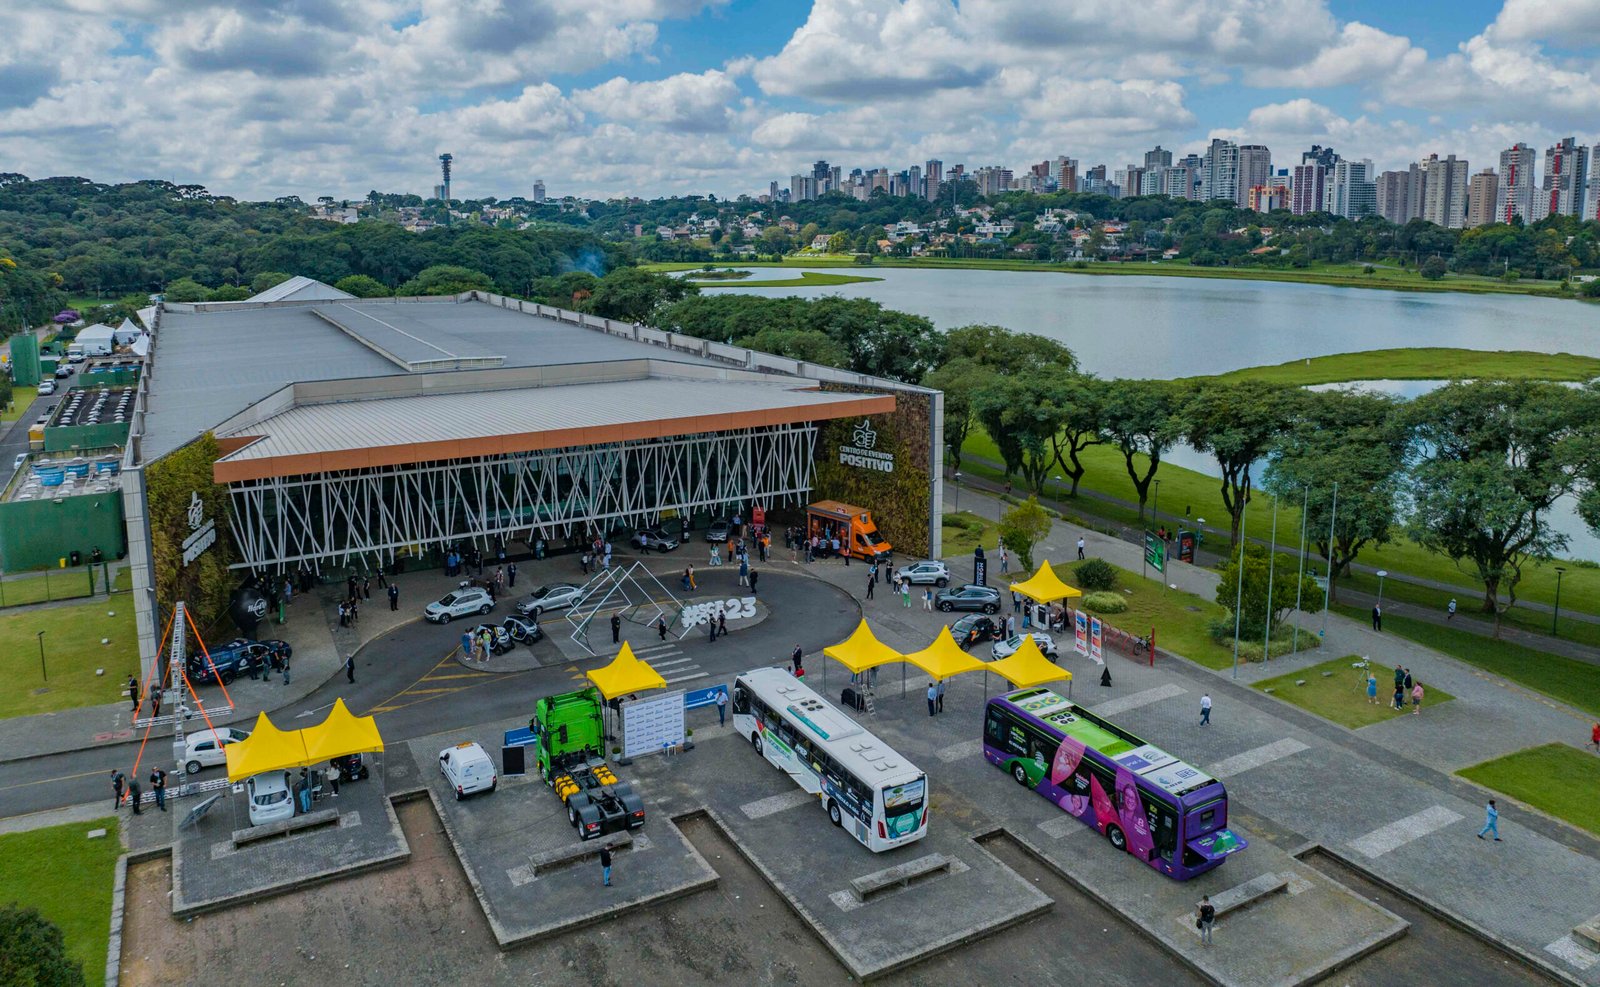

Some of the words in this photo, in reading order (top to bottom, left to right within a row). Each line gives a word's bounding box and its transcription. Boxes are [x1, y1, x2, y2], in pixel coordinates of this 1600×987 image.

[839, 446, 860, 455] CENTRO
[860, 449, 869, 457] DE
[868, 450, 894, 460] EVENTOS
[840, 453, 893, 472] POSITIVO
